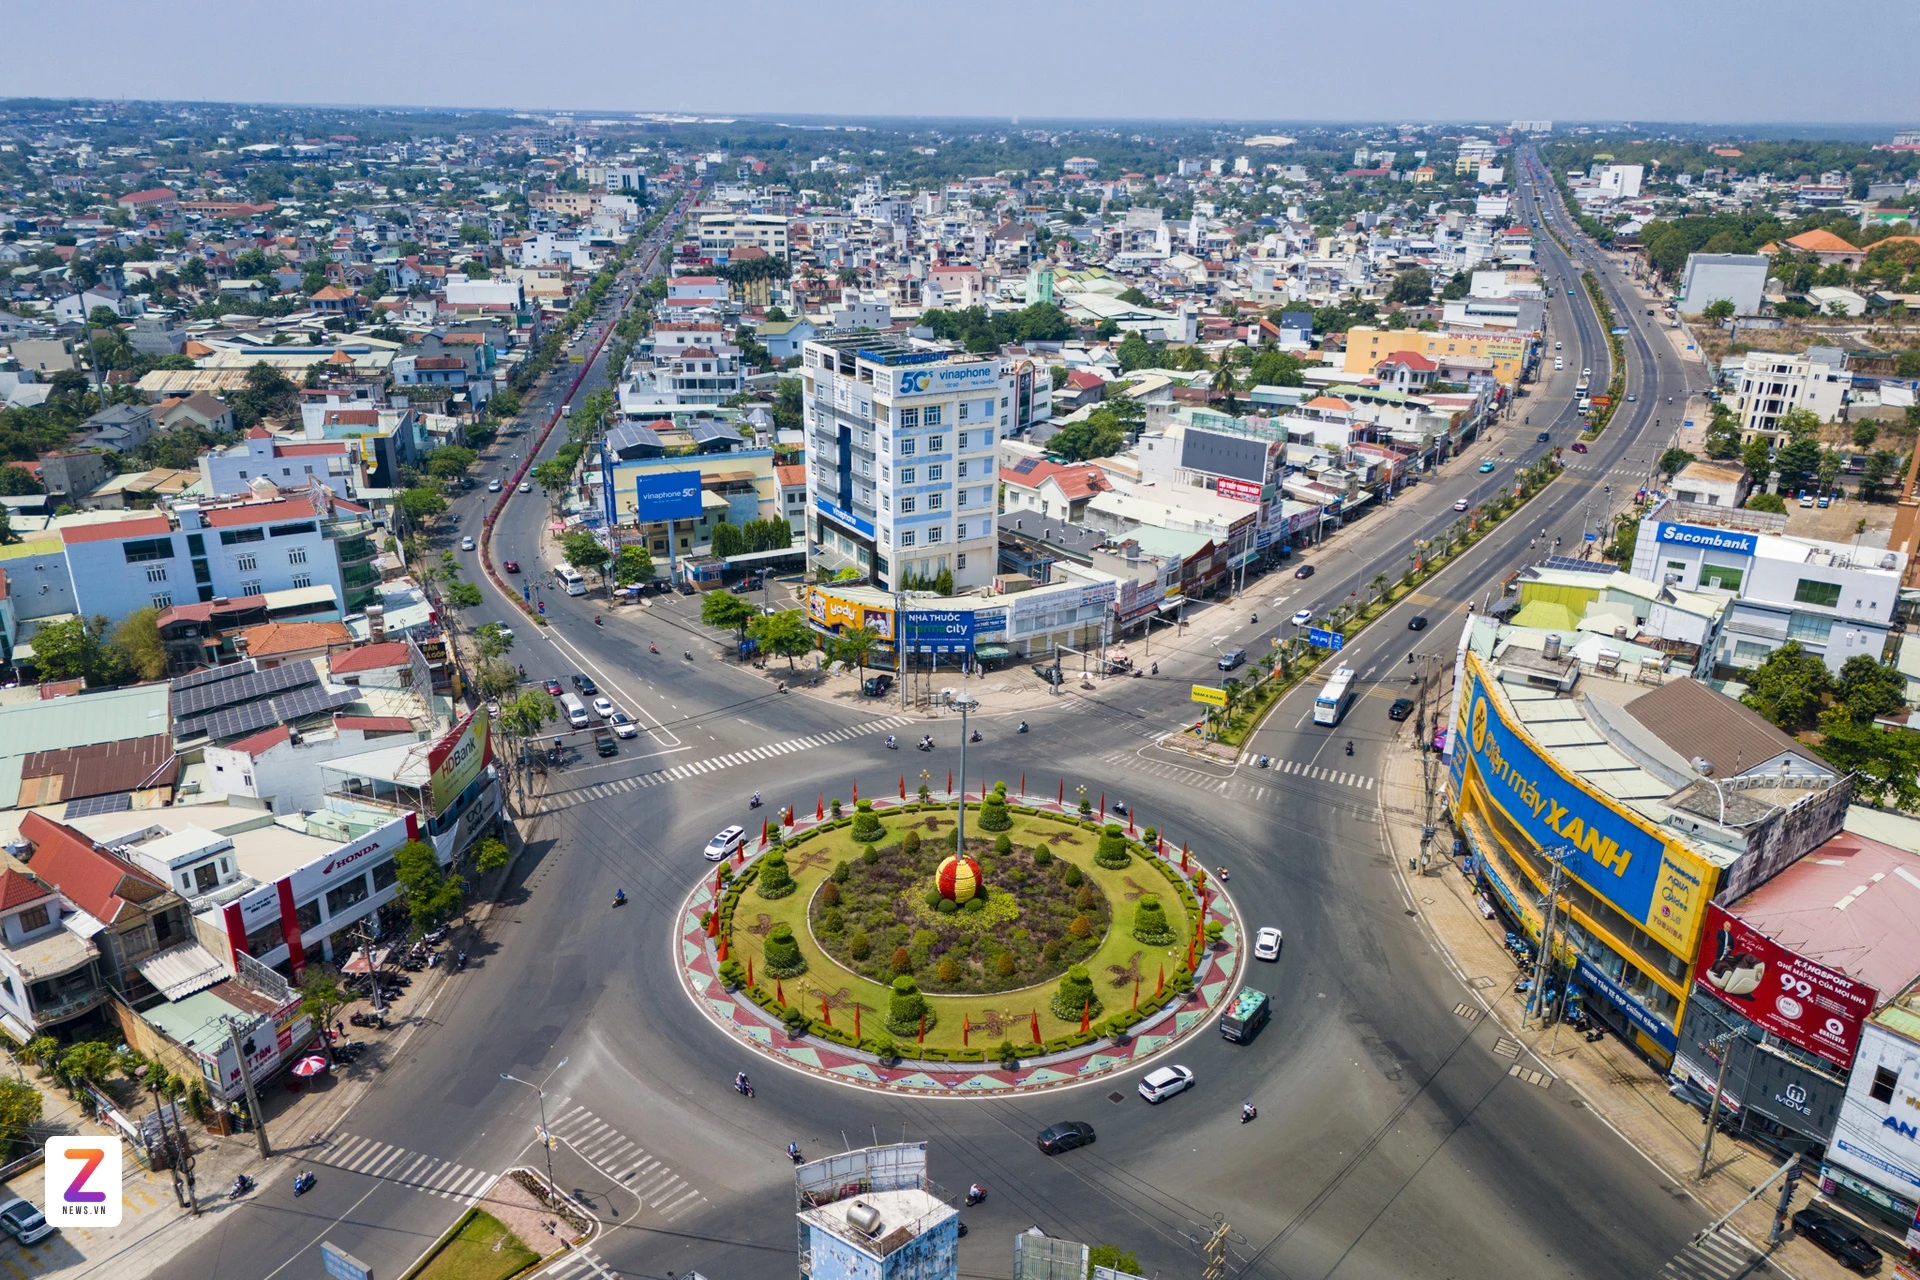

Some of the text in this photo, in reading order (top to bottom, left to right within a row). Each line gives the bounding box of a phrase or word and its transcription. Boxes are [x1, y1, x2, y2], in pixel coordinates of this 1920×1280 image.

[940, 368, 991, 381] vinaphone
[643, 490, 681, 500] vinaphone
[832, 506, 856, 526] vinaphone
[1663, 526, 1750, 551] Sacombank
[830, 603, 856, 621] yody
[908, 612, 960, 622] NHÀ THUỐC
[440, 737, 476, 779] HDBank
[1508, 768, 1548, 819] máy
[1544, 797, 1632, 878] XANH
[336, 842, 380, 868] HONDA
[1663, 857, 1700, 887] Panasonic
[1667, 875, 1689, 894] AQUA
[1653, 915, 1683, 941] TOSHIBA
[1582, 966, 1597, 984] TRUNG
[1597, 978, 1608, 994] TÂM
[1608, 988, 1616, 999] XE
[1615, 994, 1626, 1006] ĐẠP
[1626, 1002, 1643, 1021] CHÍNH
[1818, 980, 1834, 992] CỦA
[1834, 986, 1850, 998] MỌI
[1850, 993, 1867, 1006] NHÀ
[1776, 1094, 1812, 1116] MOVE
